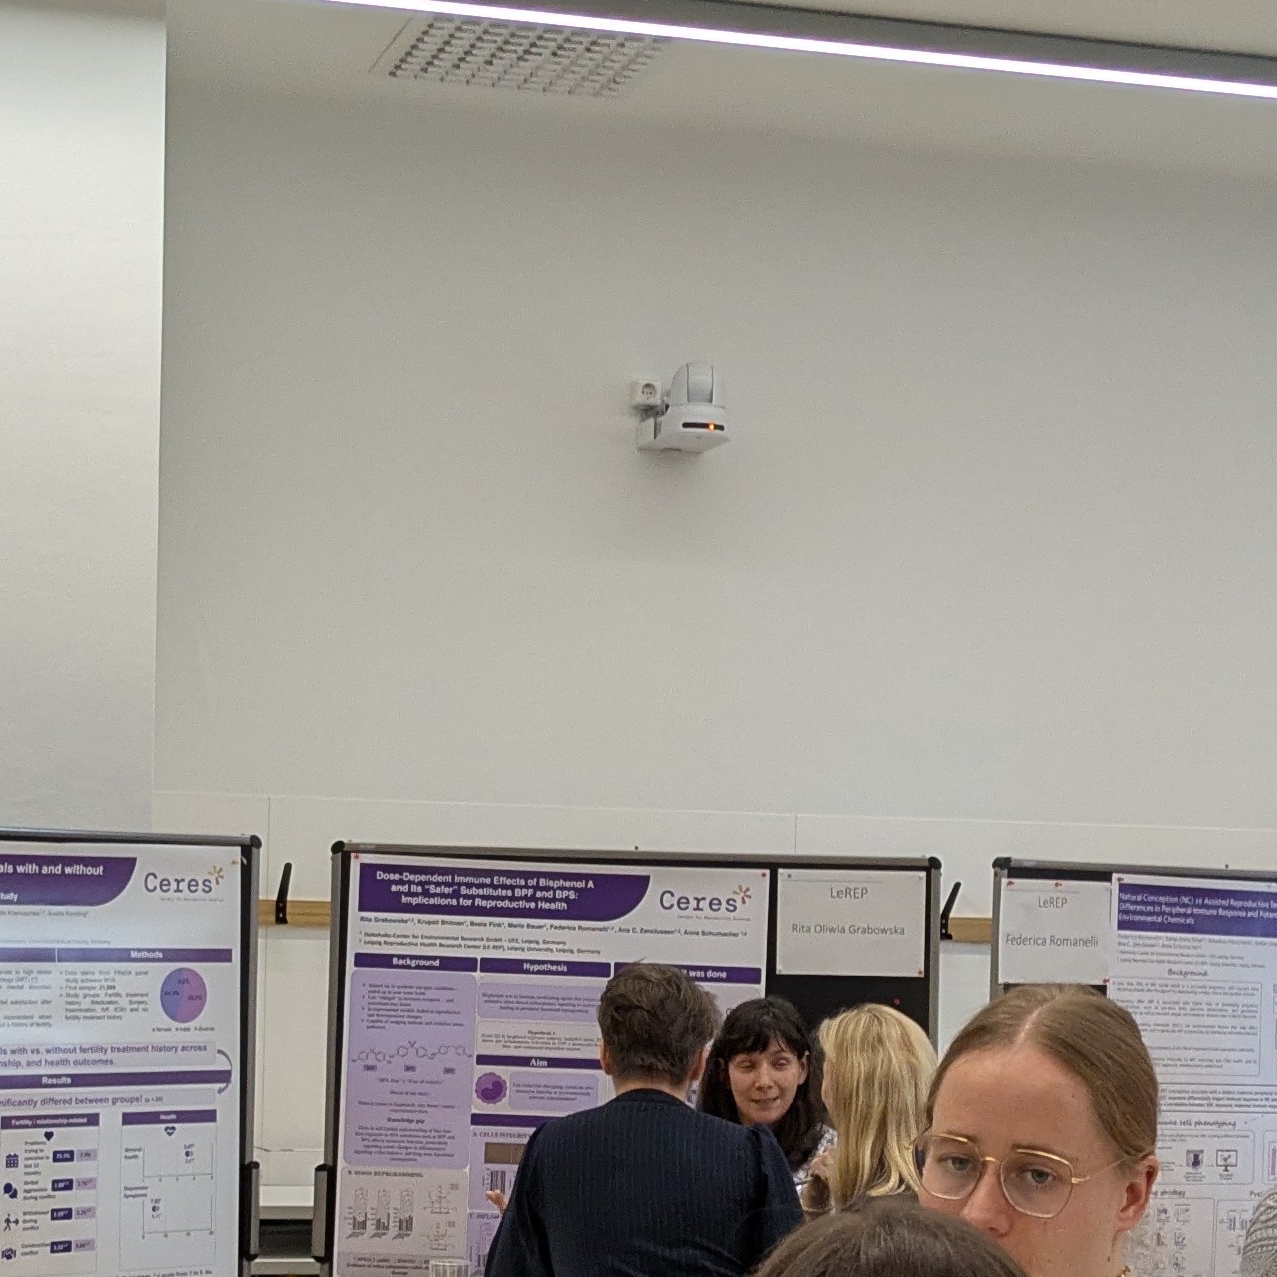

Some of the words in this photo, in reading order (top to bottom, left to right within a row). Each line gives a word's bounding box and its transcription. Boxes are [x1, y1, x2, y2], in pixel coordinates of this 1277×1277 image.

[16, 862, 38, 874] with
[42, 863, 62, 875] and
[65, 863, 104, 876] without
[144, 872, 213, 894] Ceres
[377, 871, 452, 885] Dose-Dependent
[454, 873, 491, 885] Immune
[493, 875, 525, 886] Effects
[527, 876, 537, 886] of
[540, 877, 585, 890] Bisphenol
[586, 879, 595, 889] A
[391, 883, 409, 893] and
[460, 886, 512, 898] Substitutes
[515, 889, 534, 898] BPF
[536, 889, 553, 899] and
[555, 890, 579, 900] BPS:
[831, 887, 868, 900] LeREP
[401, 895, 457, 908] Implications
[459, 897, 472, 907] for
[475, 898, 535, 910] Reproductive
[538, 900, 568, 911] Health
[660, 890, 738, 913] Ceres
[1038, 896, 1068, 909] LeREP
[1143, 894, 1179, 905] Conception
[1230, 899, 1269, 910] Reproductive
[1119, 903, 1154, 913] Differences
[1155, 905, 1161, 913] in
[1218, 908, 1247, 918] Response
[1248, 909, 1259, 919] and
[1119, 912, 1163, 923] Environmental
[1163, 915, 1195, 925] Chemicals
[792, 924, 811, 934] Rita
[814, 924, 845, 934] Oliwia
[849, 925, 905, 936] Grabowska
[1005, 934, 1047, 947] Federica
[1050, 935, 1099, 948] Romanelli
[130, 951, 163, 959] Methods
[393, 957, 440, 968] Background
[523, 962, 568, 974] Hypothesis
[689, 970, 705, 978] was
[706, 970, 727, 979] done
[1168, 968, 1209, 979] Background
[10, 1047, 29, 1056] with
[45, 1046, 77, 1055] without
[78, 1044, 108, 1056] fertility
[111, 1045, 149, 1054] treatment
[151, 1043, 179, 1054] history
[181, 1044, 207, 1052] across
[26, 1058, 42, 1067] and
[45, 1058, 71, 1067] health
[529, 1058, 548, 1067] Aim
[42, 1075, 71, 1085] Results
[40, 1097, 72, 1106] differed
[75, 1096, 109, 1105] between
[111, 1095, 143, 1105] groups!
[11, 1118, 33, 1127] Fertility
